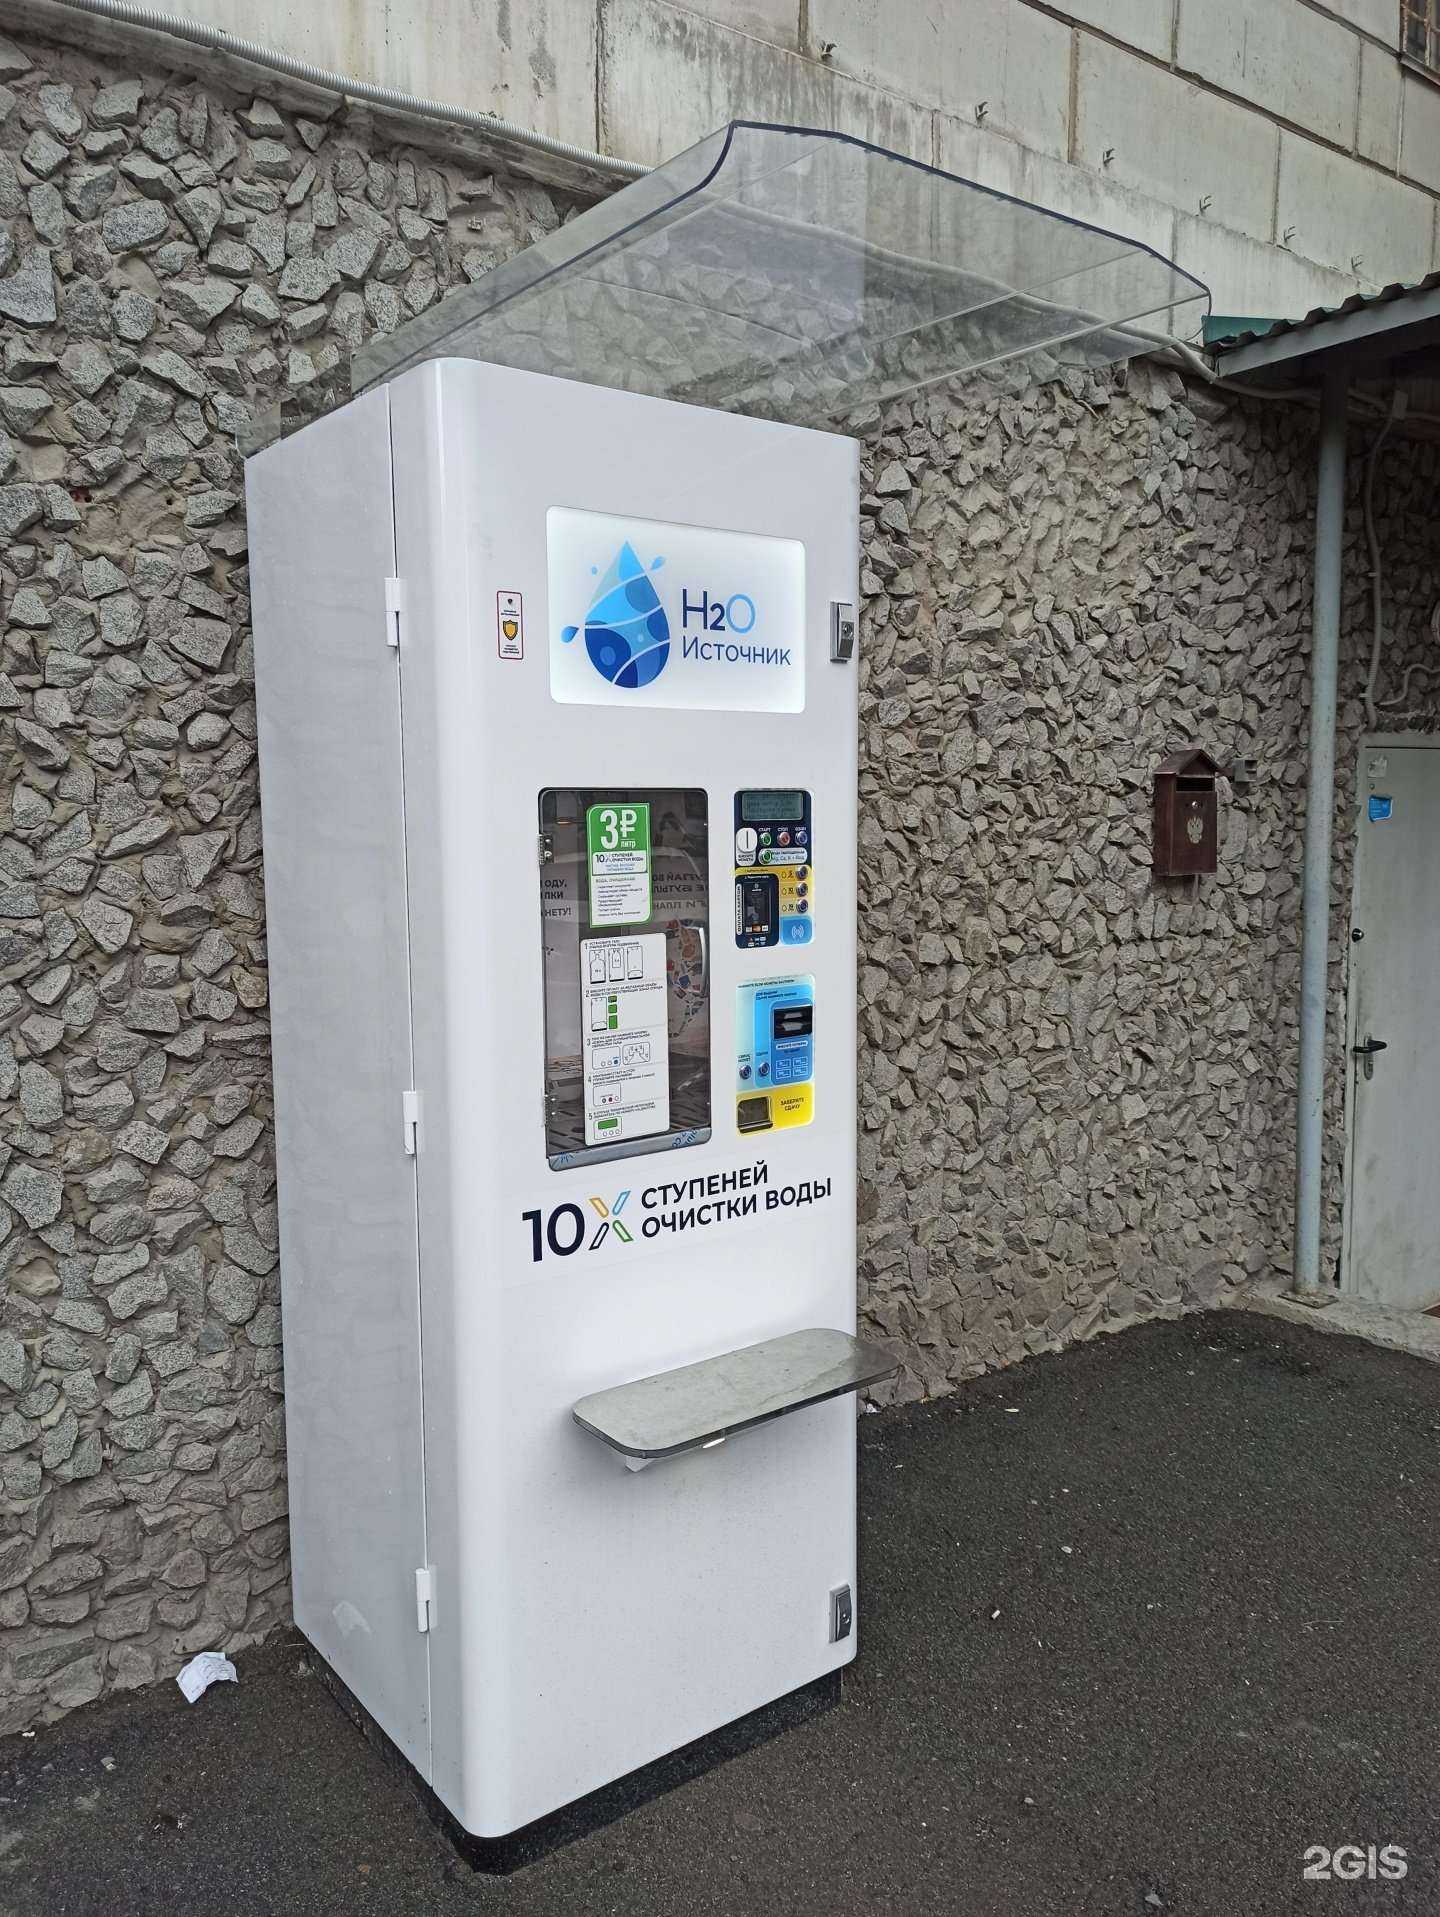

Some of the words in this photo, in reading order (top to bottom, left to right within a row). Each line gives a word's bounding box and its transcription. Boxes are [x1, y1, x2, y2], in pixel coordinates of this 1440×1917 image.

[682, 634, 792, 666] Источник
[640, 1159, 768, 1209] СТУПЕНЕЙ
[641, 1193, 758, 1238] ОЧИСТКИ
[765, 1177, 832, 1211] ВОДЫ
